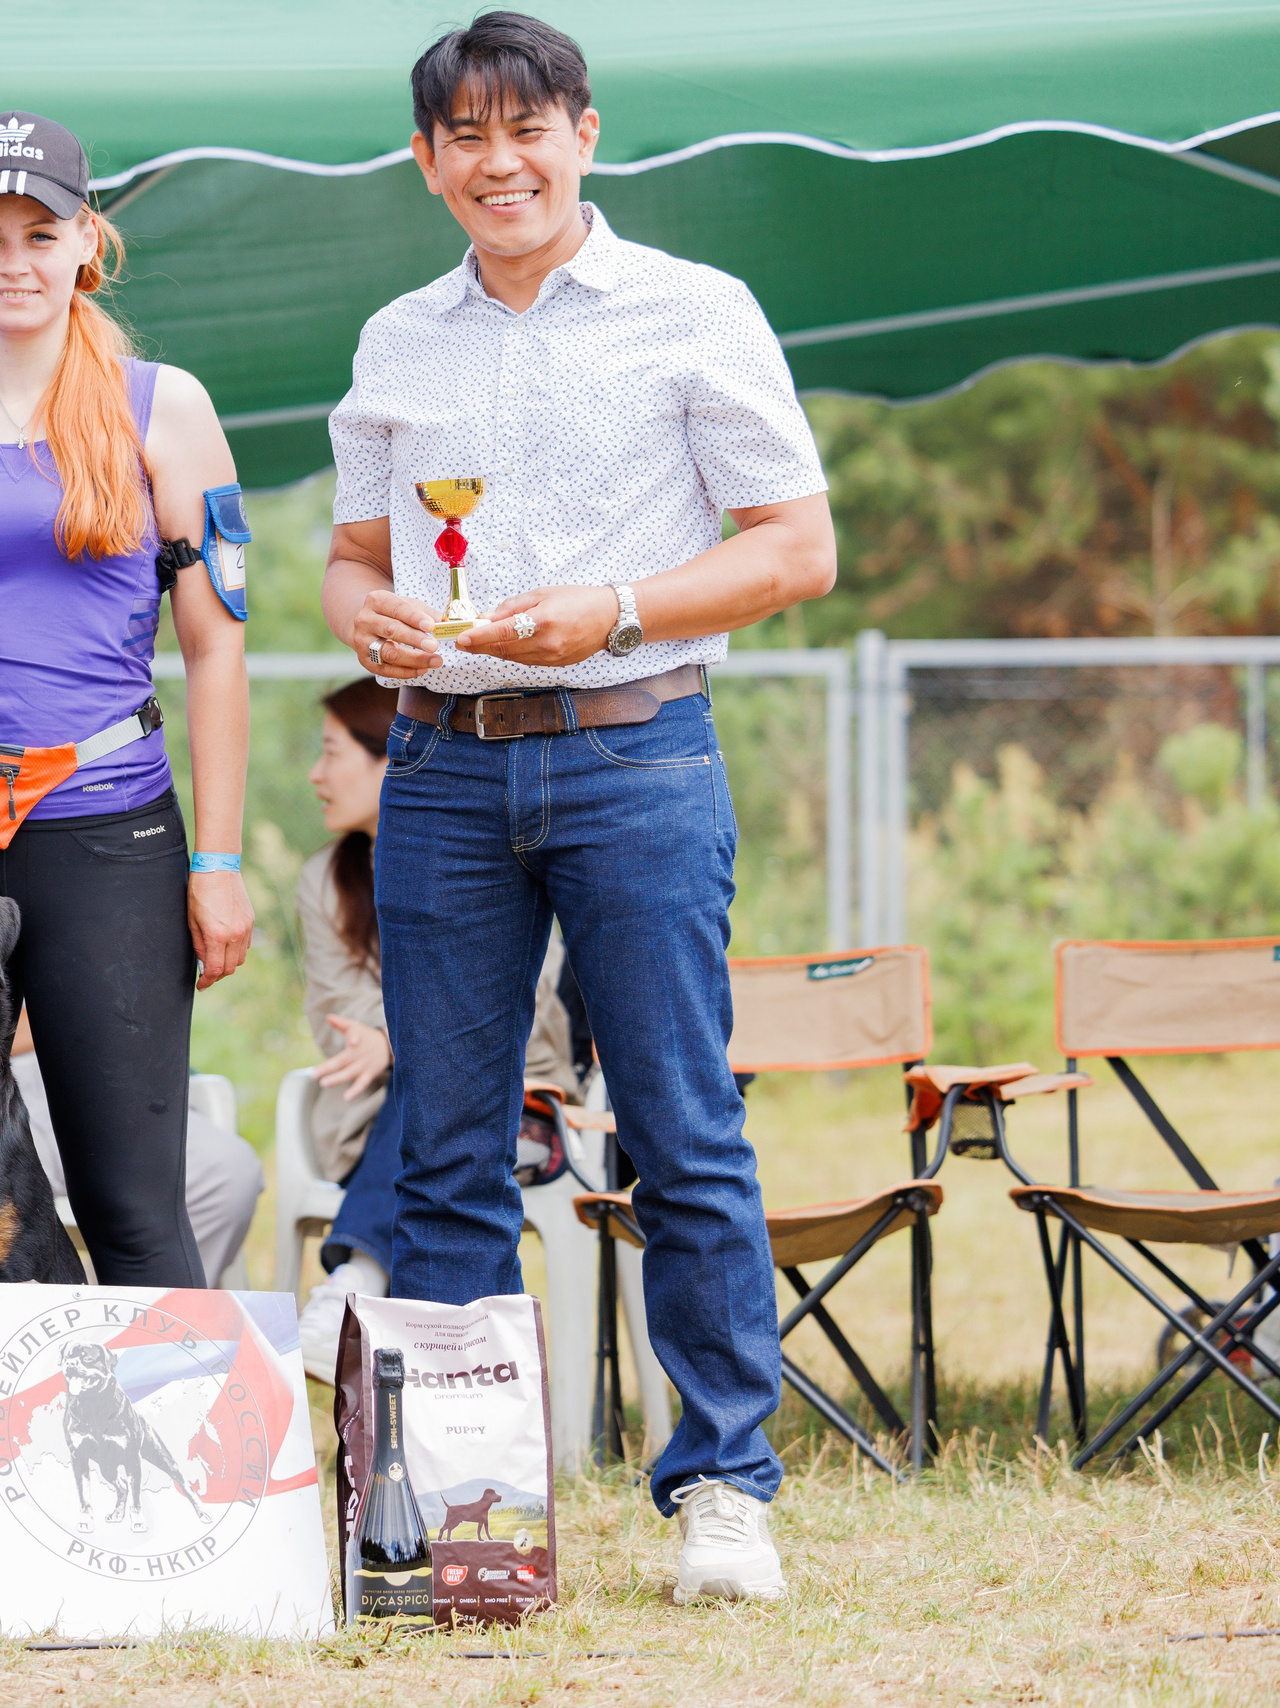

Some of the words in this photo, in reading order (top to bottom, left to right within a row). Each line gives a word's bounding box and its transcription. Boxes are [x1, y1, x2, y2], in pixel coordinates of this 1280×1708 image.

[82, 782, 115, 793] Reebok
[132, 825, 167, 840] Reebok
[405, 1321, 423, 1329] Корм
[420, 1342, 457, 1352] курицей
[434, 1392, 483, 1400] premium
[103, 1304, 199, 1350] КЛУБ
[210, 1358, 264, 1508] РОССИИ
[388, 1393, 399, 1450] SEMI-SWEET
[446, 1425, 486, 1435] PUPPY
[67, 1536, 217, 1577] РКФ-НКПР
[446, 1568, 464, 1576] FRESH
[446, 1575, 461, 1583] MEAT
[361, 1595, 374, 1606] DI
[377, 1594, 429, 1607] CASPICO
